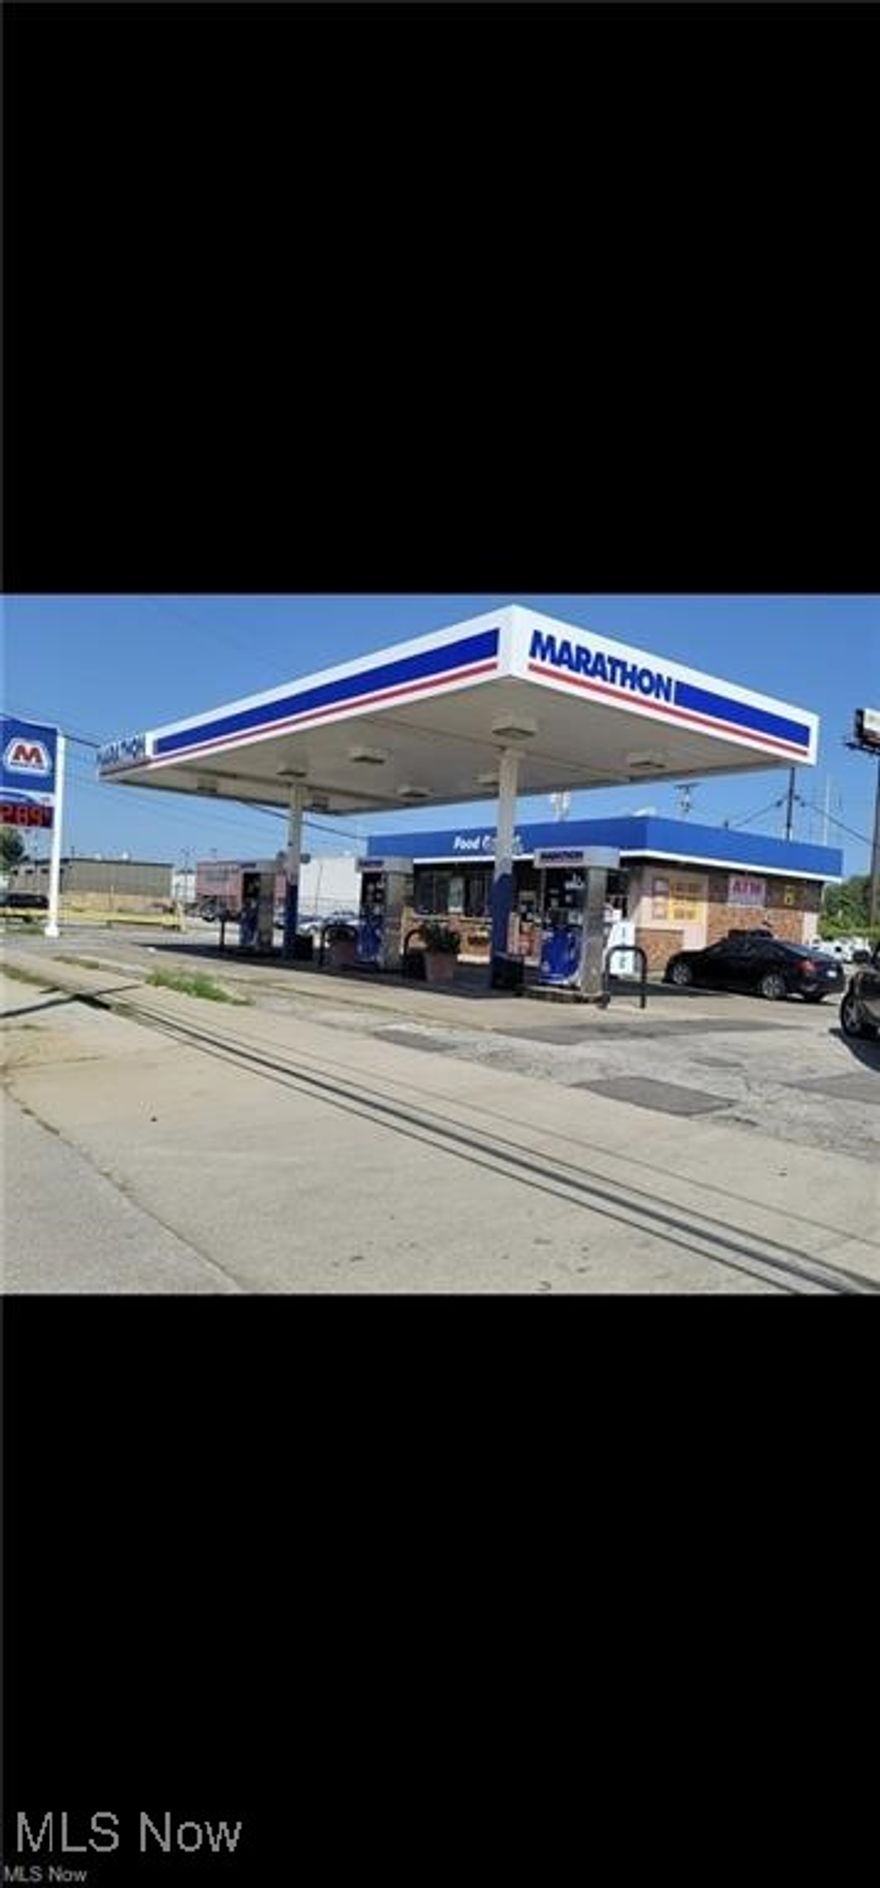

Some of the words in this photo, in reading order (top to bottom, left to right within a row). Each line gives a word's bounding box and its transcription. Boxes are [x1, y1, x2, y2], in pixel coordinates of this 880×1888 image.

[529, 629, 673, 703] MARATHON
[12, 745, 43, 763] M
[453, 836, 480, 850] Food
